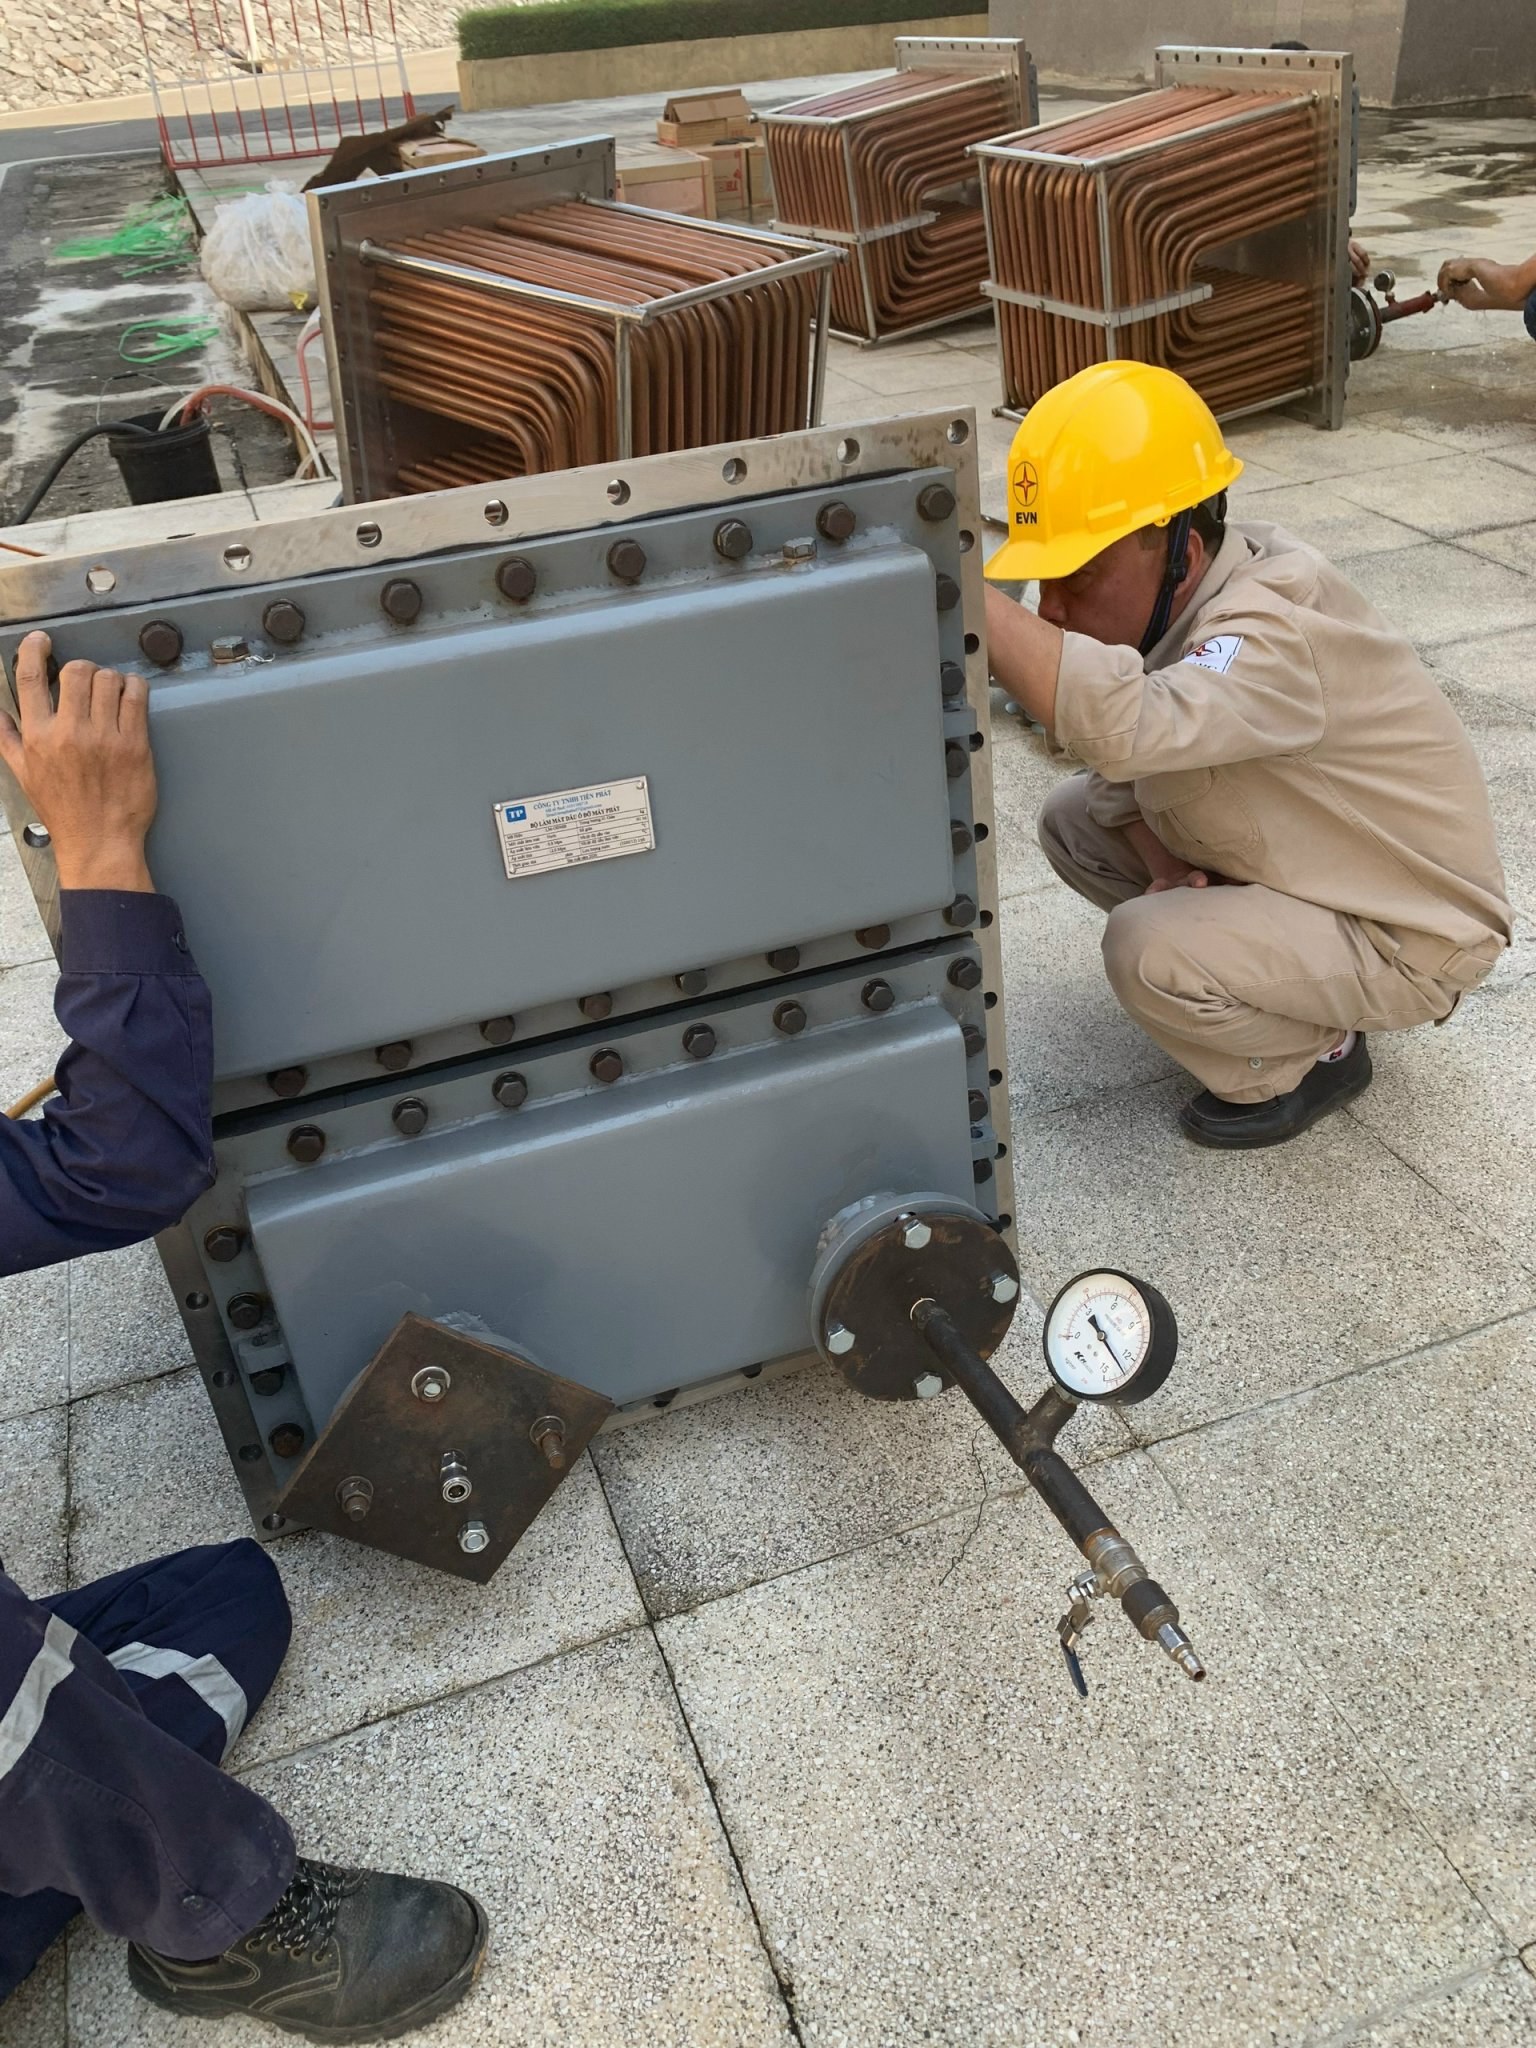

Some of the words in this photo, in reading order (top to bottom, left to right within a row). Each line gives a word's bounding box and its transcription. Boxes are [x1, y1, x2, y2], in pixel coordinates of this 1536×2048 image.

[1016, 512, 1037, 524] EVN
[508, 809, 523, 819] TP
[1111, 1302, 1118, 1311] 6
[1086, 1308, 1092, 1316] 3
[1128, 1321, 1135, 1330] 9
[1074, 1331, 1081, 1339] 0
[1122, 1349, 1132, 1361] 12
[1099, 1362, 1110, 1374] 15
